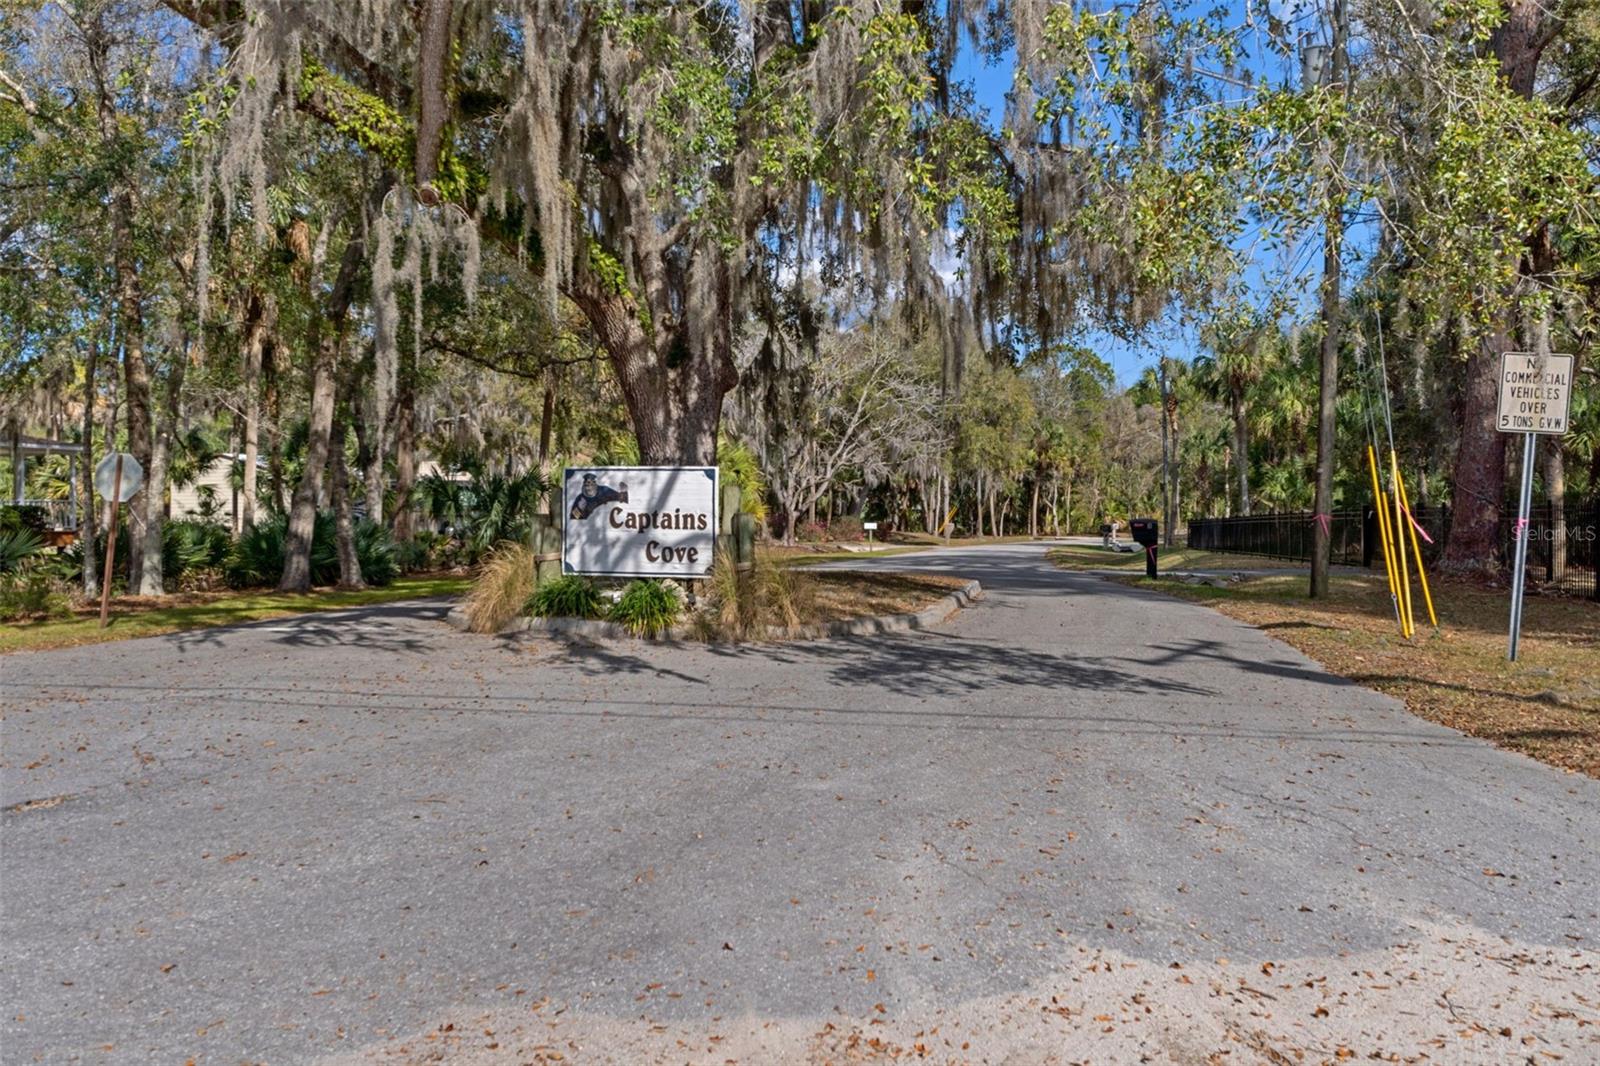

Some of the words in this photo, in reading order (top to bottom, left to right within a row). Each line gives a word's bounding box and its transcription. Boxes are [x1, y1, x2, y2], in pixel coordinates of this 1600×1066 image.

[1505, 371, 1567, 386] COMMCIAL
[1510, 386, 1560, 400] VEHICLES
[1520, 401, 1547, 414] OVER
[1501, 415, 1509, 427] 5
[1513, 415, 1533, 428] TONS
[609, 506, 707, 533] Captains
[645, 540, 698, 563] Cove
